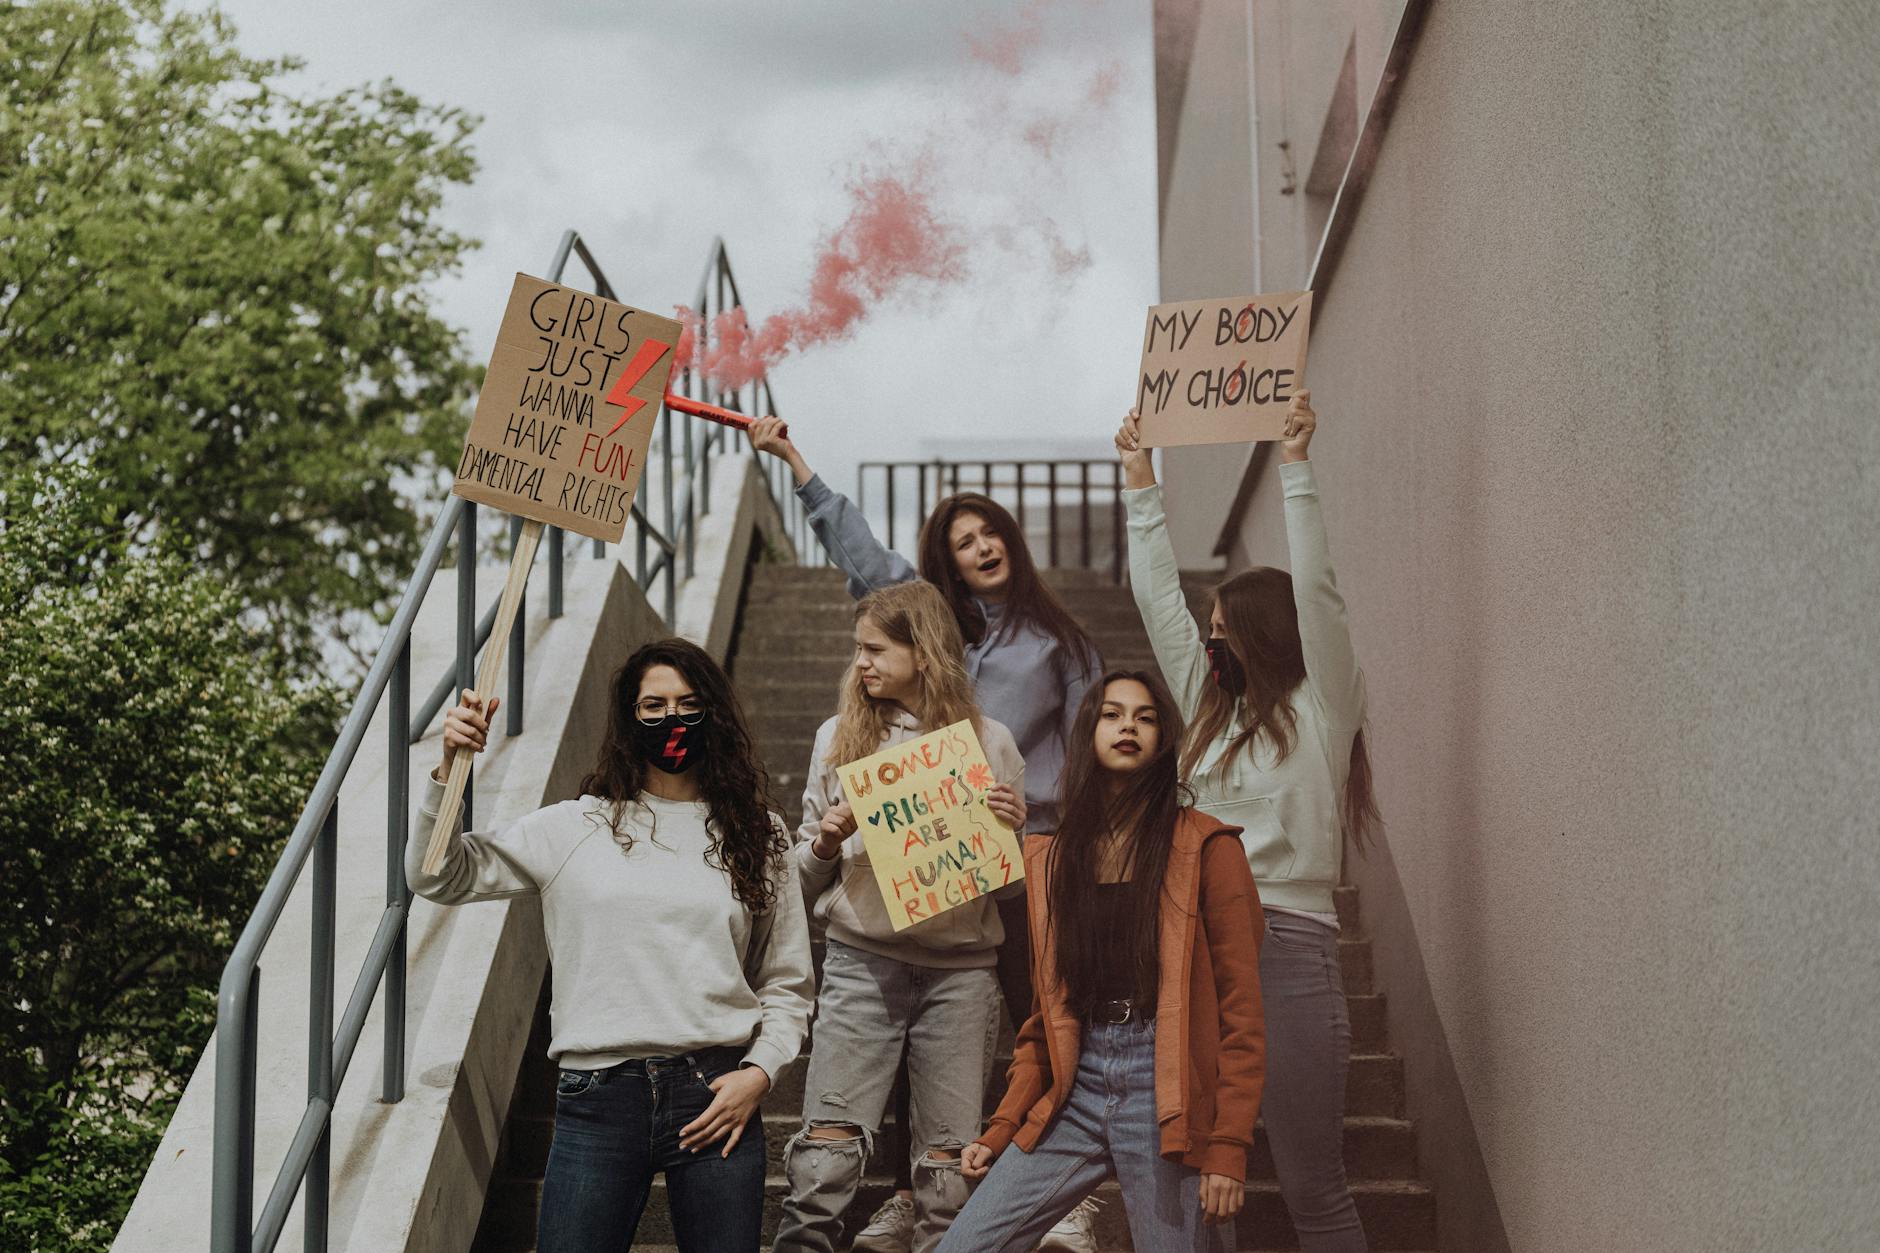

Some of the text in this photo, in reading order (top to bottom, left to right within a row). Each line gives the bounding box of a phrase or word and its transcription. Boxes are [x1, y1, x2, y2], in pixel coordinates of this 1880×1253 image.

[530, 289, 635, 355] GIRLS
[1148, 304, 1299, 353] MY BODY
[528, 336, 620, 390] JUST
[1139, 362, 1294, 416] MY CHOICE
[520, 376, 595, 428] WANNA
[503, 413, 635, 481] HAVE FUN-
[458, 444, 628, 524] DAMENTAL RIGHTS
[904, 817, 951, 856] ARE
[904, 867, 990, 924] RIGHTS
